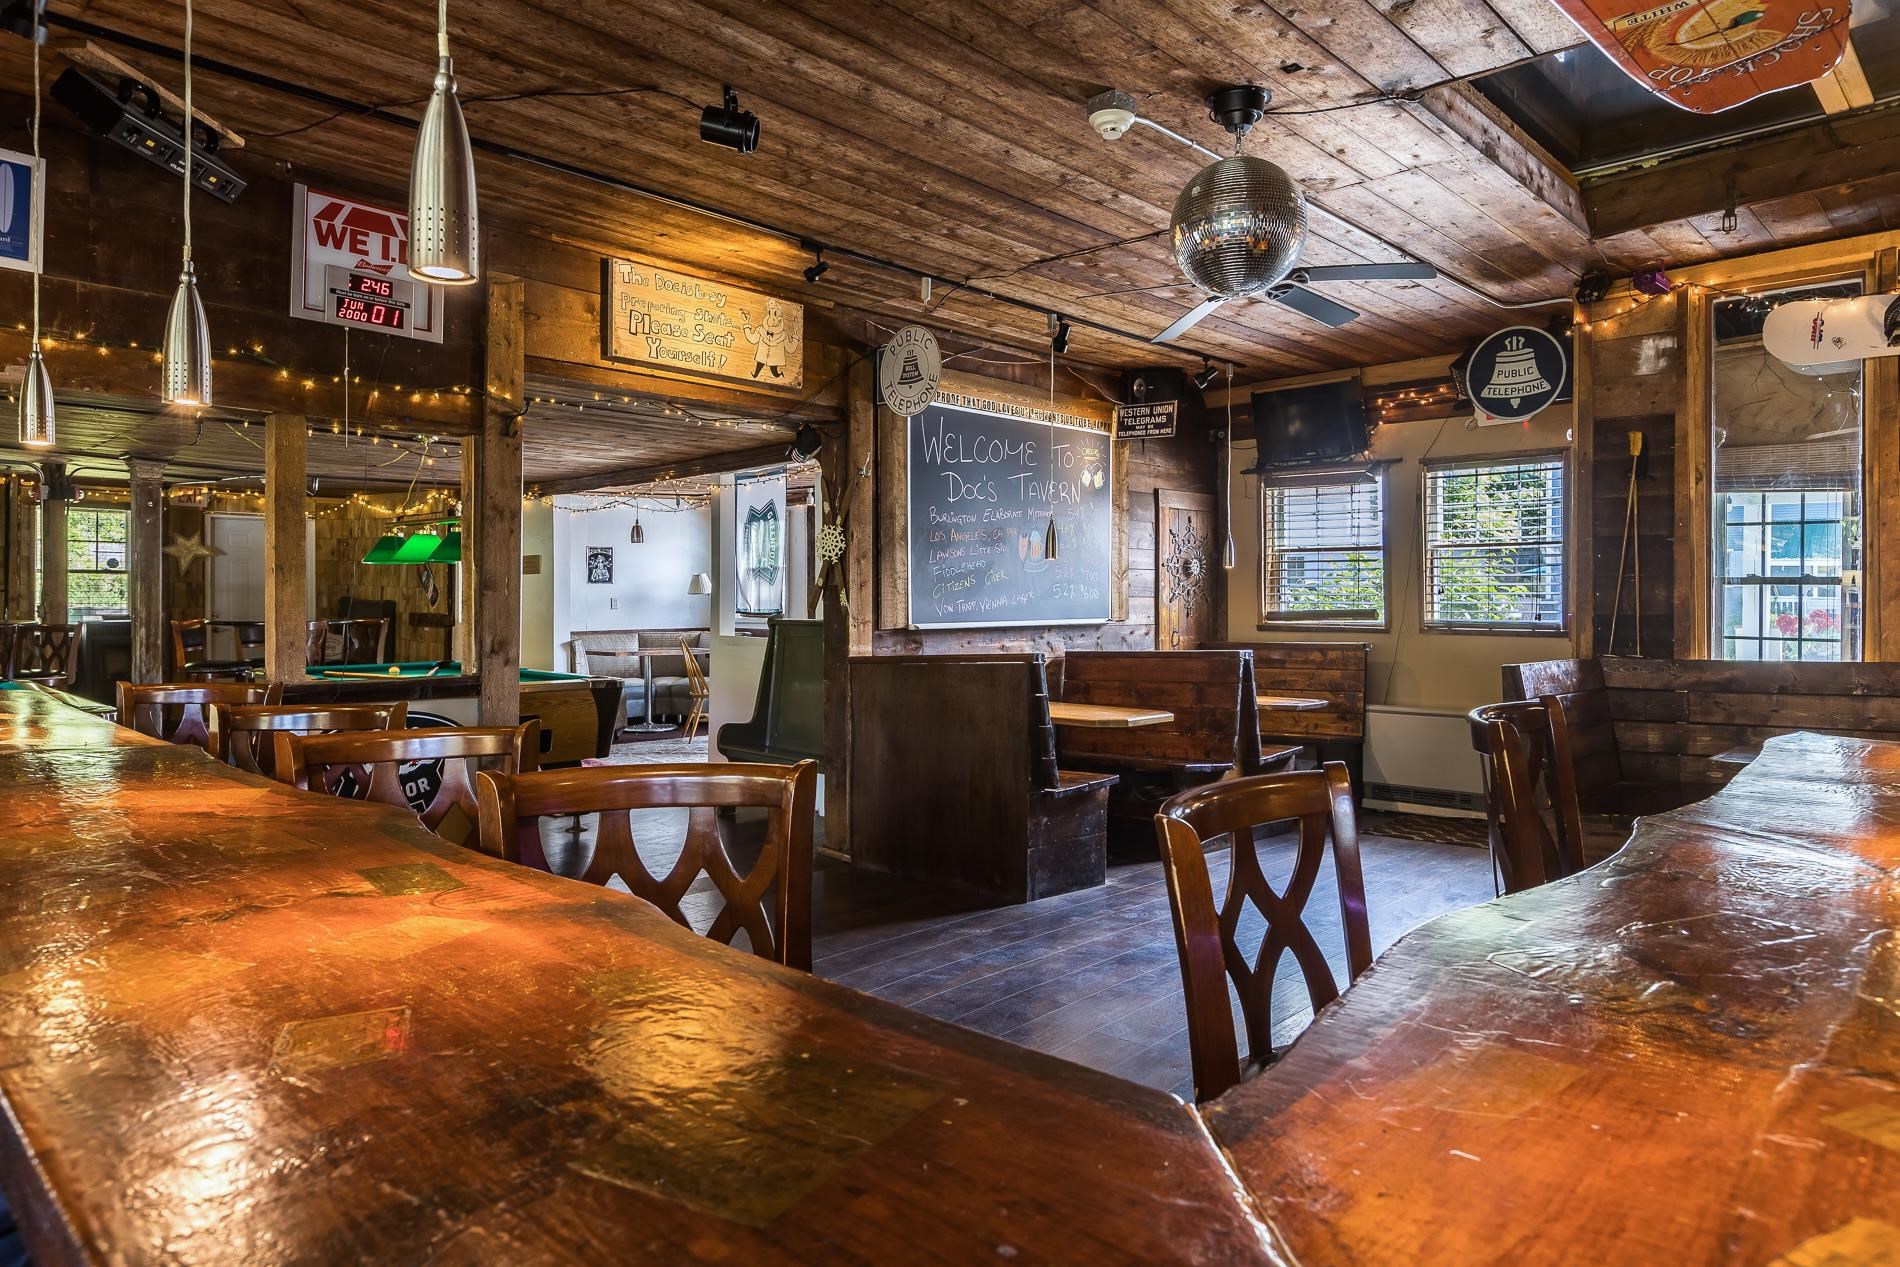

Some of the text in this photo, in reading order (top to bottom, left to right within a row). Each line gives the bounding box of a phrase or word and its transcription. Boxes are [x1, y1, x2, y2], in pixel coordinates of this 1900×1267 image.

[1628, 0, 1688, 26] WHITE
[1648, 8, 1834, 84] SHOCK TOP
[312, 219, 370, 256] WE
[619, 263, 727, 308] The Doc is busy
[338, 308, 368, 321] 2000
[344, 298, 364, 310] JUN
[371, 306, 400, 326] 01
[628, 309, 735, 348] Please Seat
[890, 329, 932, 356] PUBLIC
[902, 370, 919, 378] SYSTEM
[1497, 366, 1534, 378] PUBLIC
[885, 373, 938, 413] TELEPHONE
[1487, 381, 1546, 396] TELEPHONE
[936, 392, 960, 405] PROOF
[962, 396, 982, 409] THAT
[982, 399, 996, 412] GOD
[997, 402, 1019, 416] LOVES
[1119, 404, 1173, 417] WESTERN UNION
[1124, 415, 1167, 425] TELEGRAMS
[921, 415, 1038, 465] WELCOME
[179, 487, 203, 504] EXIT
[940, 471, 1082, 504] DOC'S TAVERN
[983, 508, 1023, 522] ELABORATE
[767, 511, 776, 571] GREENPORT
[929, 530, 946, 541] LOS
[933, 560, 986, 582] FIDDLEHEAD
[932, 574, 976, 599] CITIZENS
[985, 569, 1008, 586] CIDER
[935, 597, 954, 617] VON
[979, 595, 1008, 613] VIENNA
